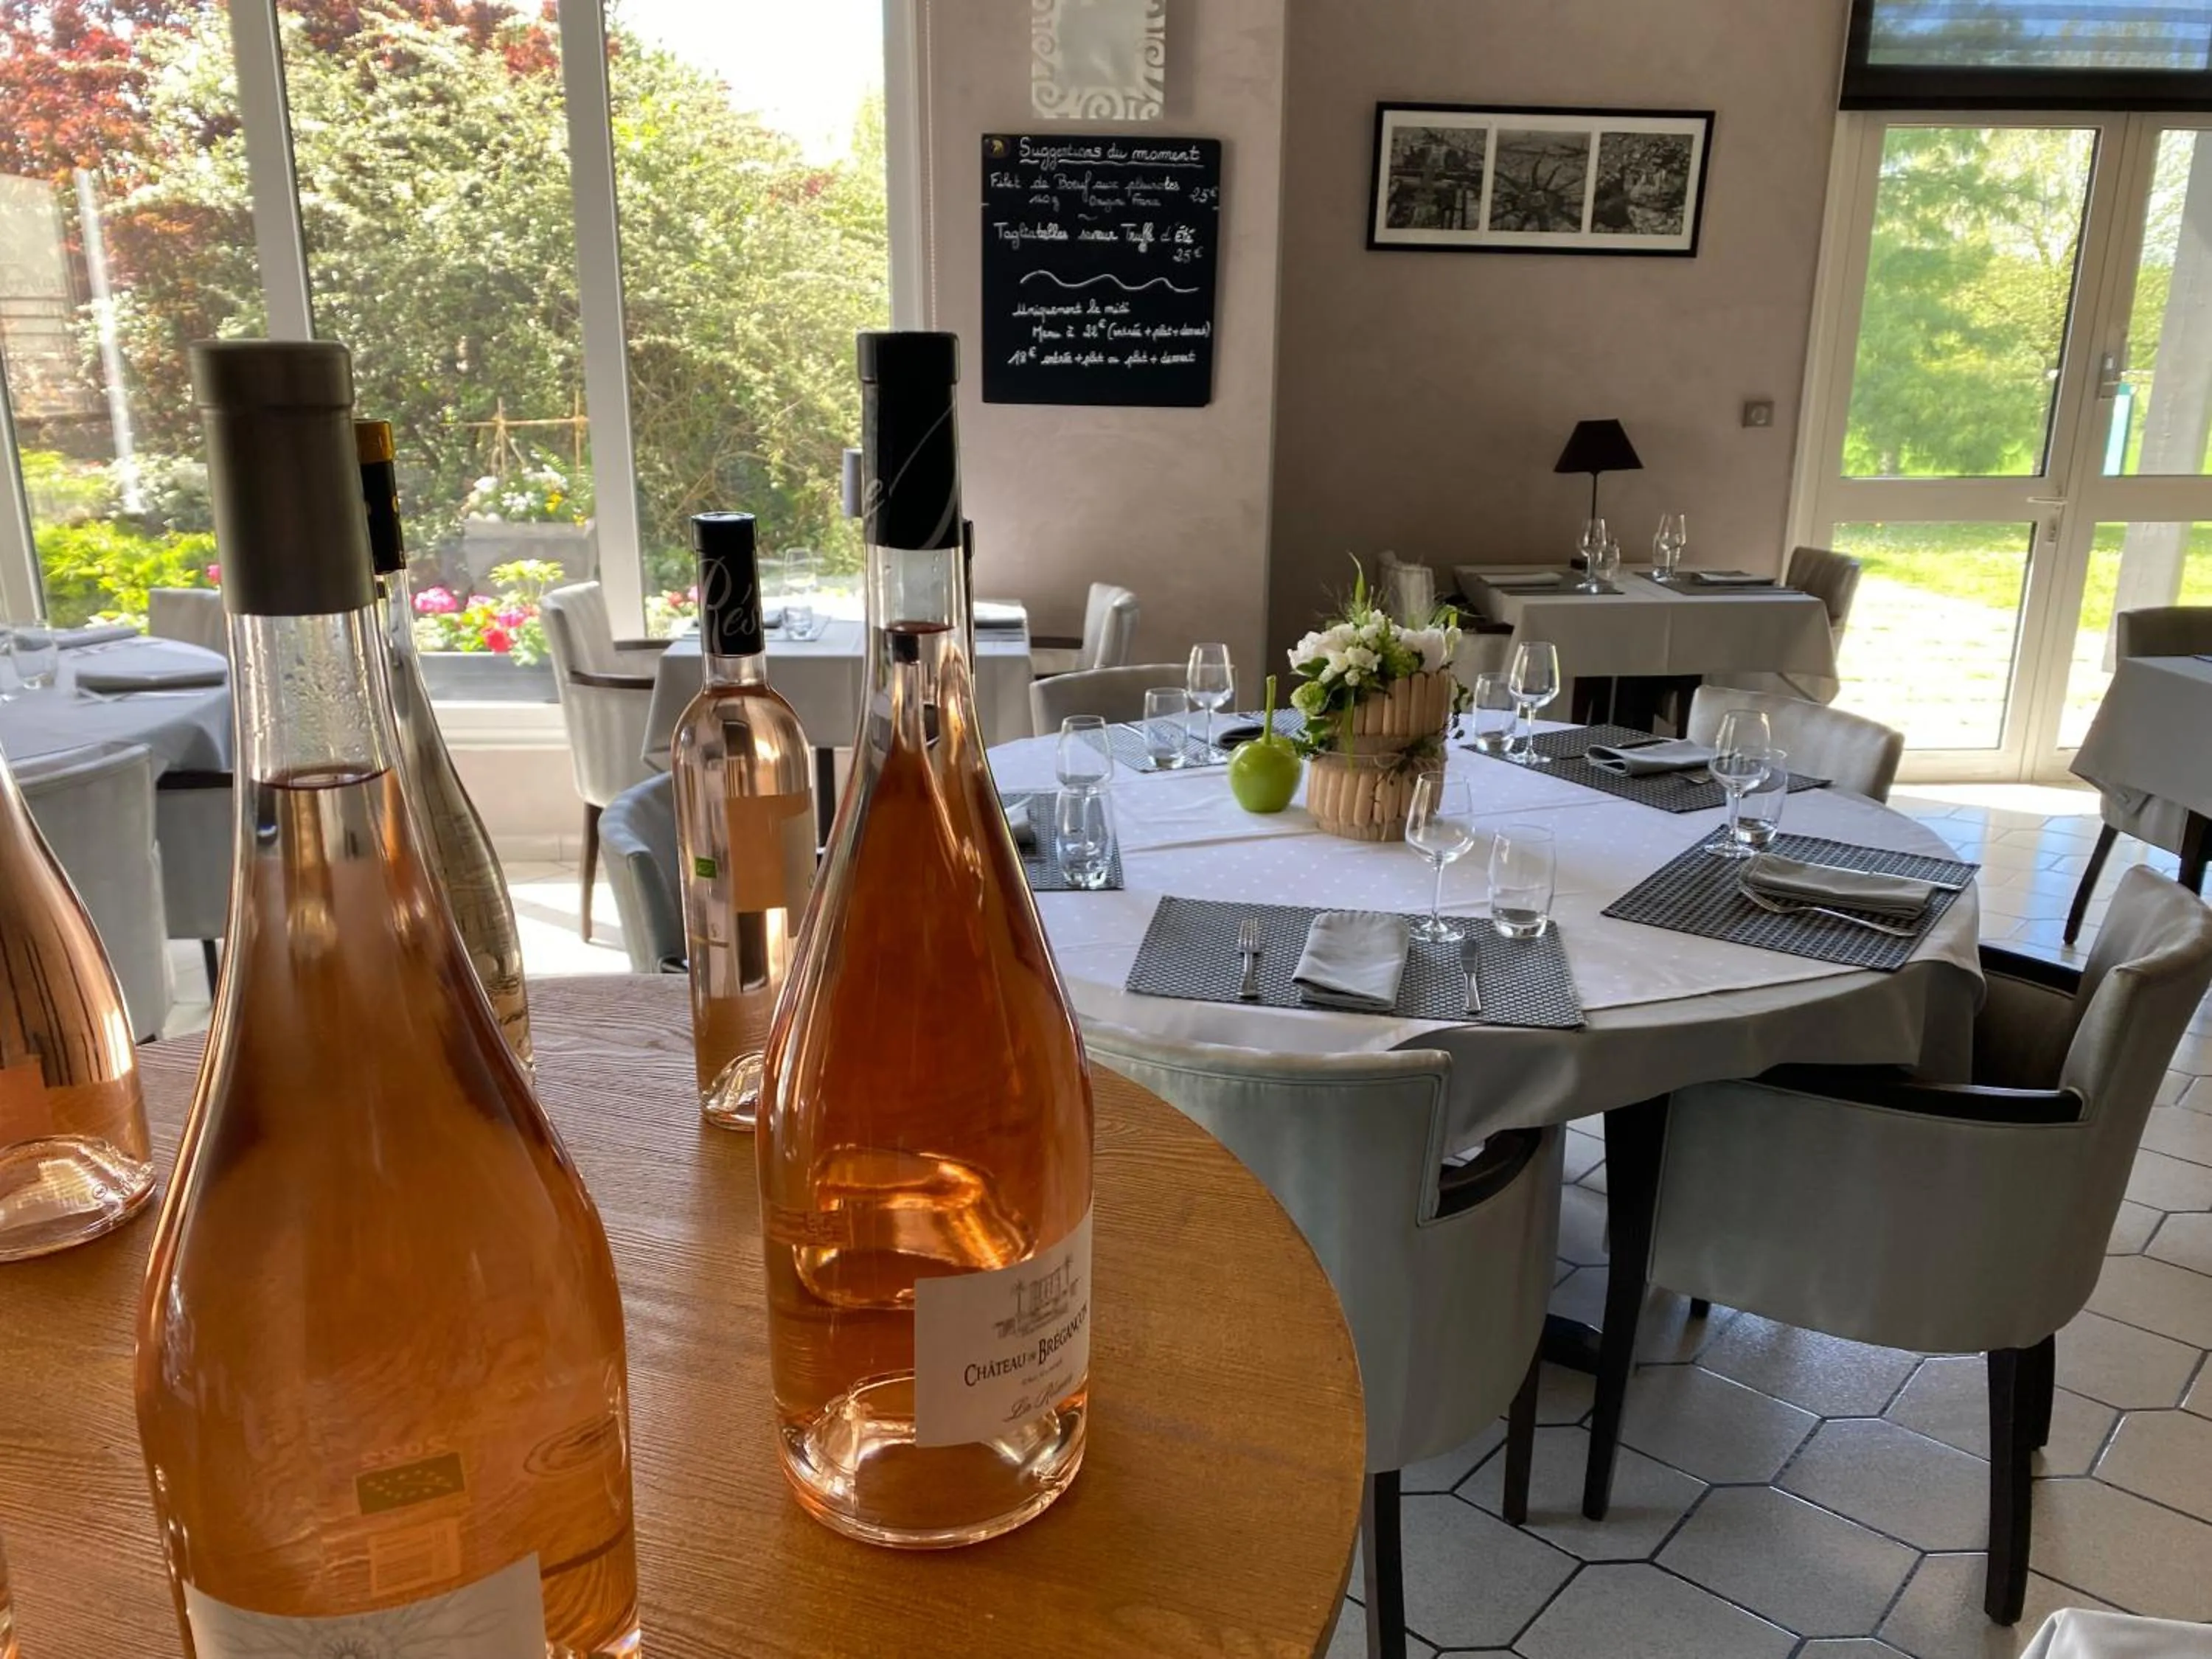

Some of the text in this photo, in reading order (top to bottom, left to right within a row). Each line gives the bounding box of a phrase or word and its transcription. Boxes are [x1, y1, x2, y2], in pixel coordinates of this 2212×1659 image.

[1019, 137, 1200, 170] Suggestions du moment
[990, 172, 1021, 189] Filet
[1086, 298, 1101, 314] le
[964, 1352, 1026, 1387] CHÂTEAU
